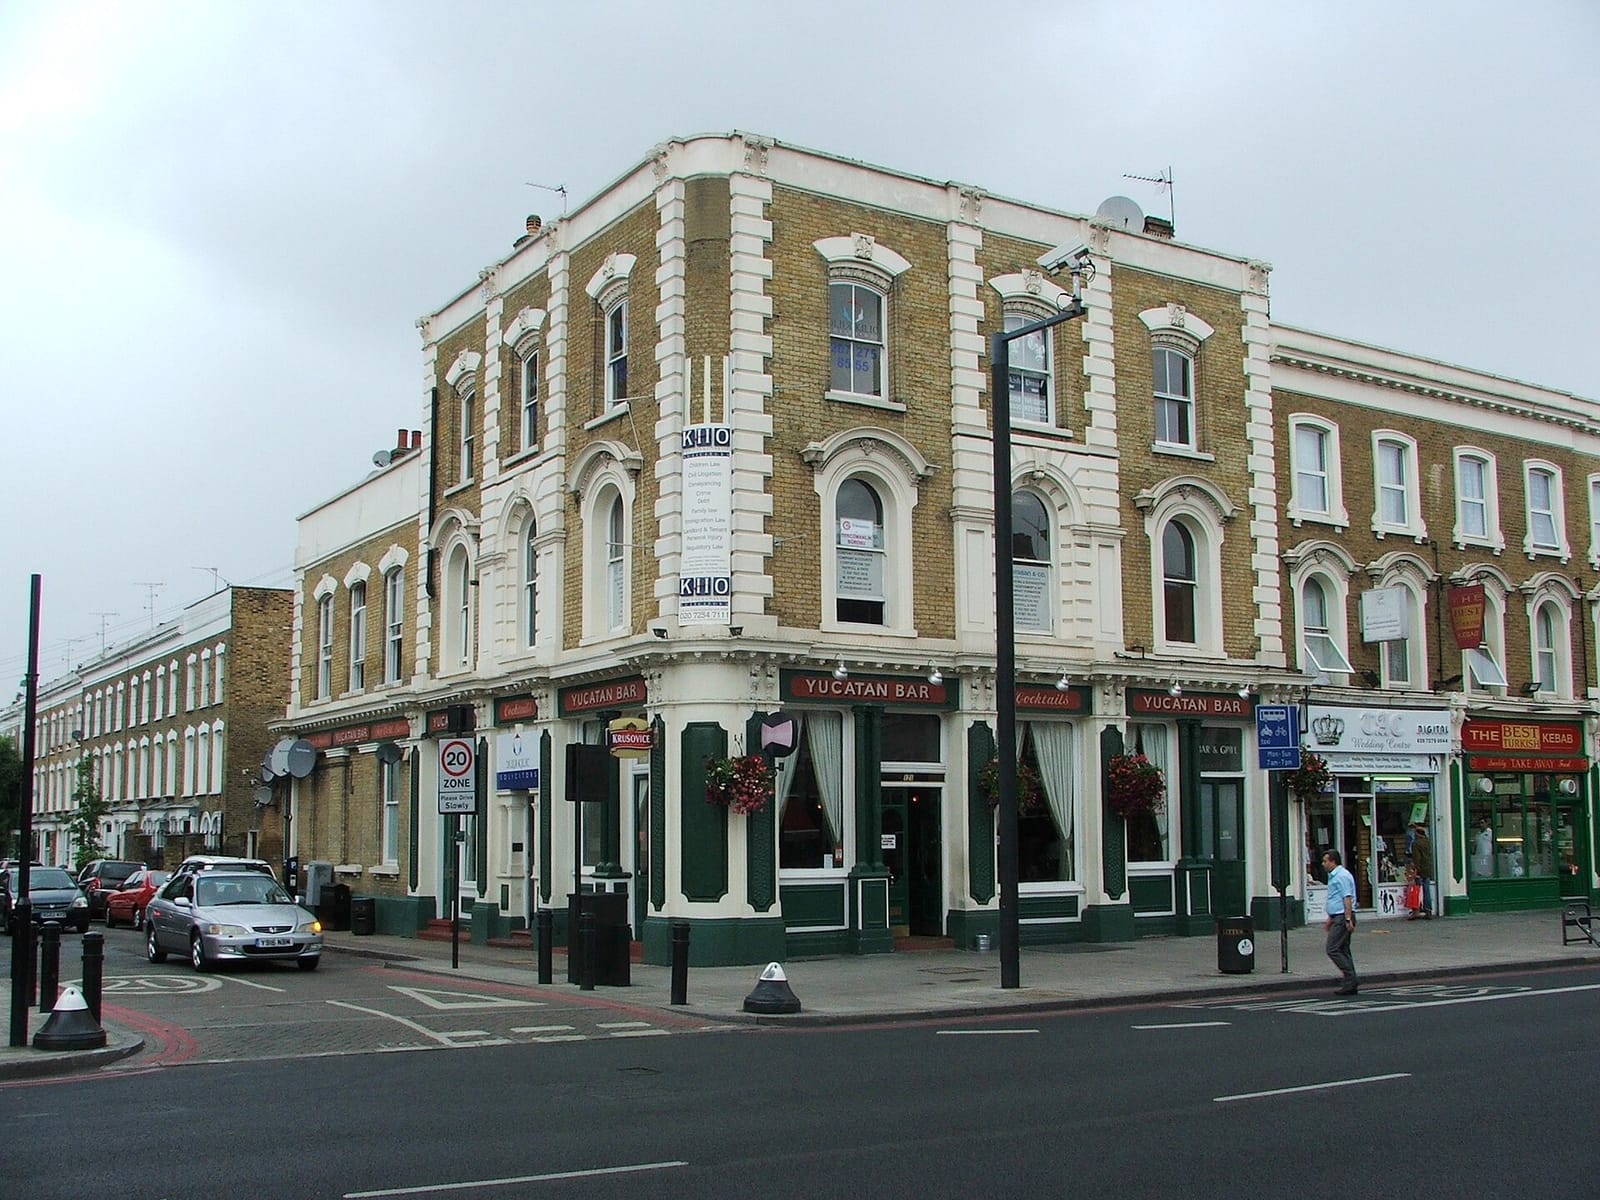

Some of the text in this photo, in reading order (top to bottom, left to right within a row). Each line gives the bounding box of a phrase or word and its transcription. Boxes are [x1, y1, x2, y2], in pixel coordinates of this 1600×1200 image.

[571, 683, 637, 707] YUCATAN BAR
[806, 678, 930, 699] YUCATAN BAR
[1143, 696, 1242, 713] YUCATAN BAR
[1418, 724, 1449, 734] DIGITAL
[1469, 725, 1574, 744] THE BEST KEBAB
[1351, 737, 1412, 750] Wedding Centre
[1503, 739, 1539, 749] TURKISH
[446, 751, 467, 766] 20
[1511, 759, 1532, 768] TAKE
[1534, 759, 1554, 768] AWAY
[443, 778, 471, 789] ZONE
[445, 801, 469, 810] Slowly
